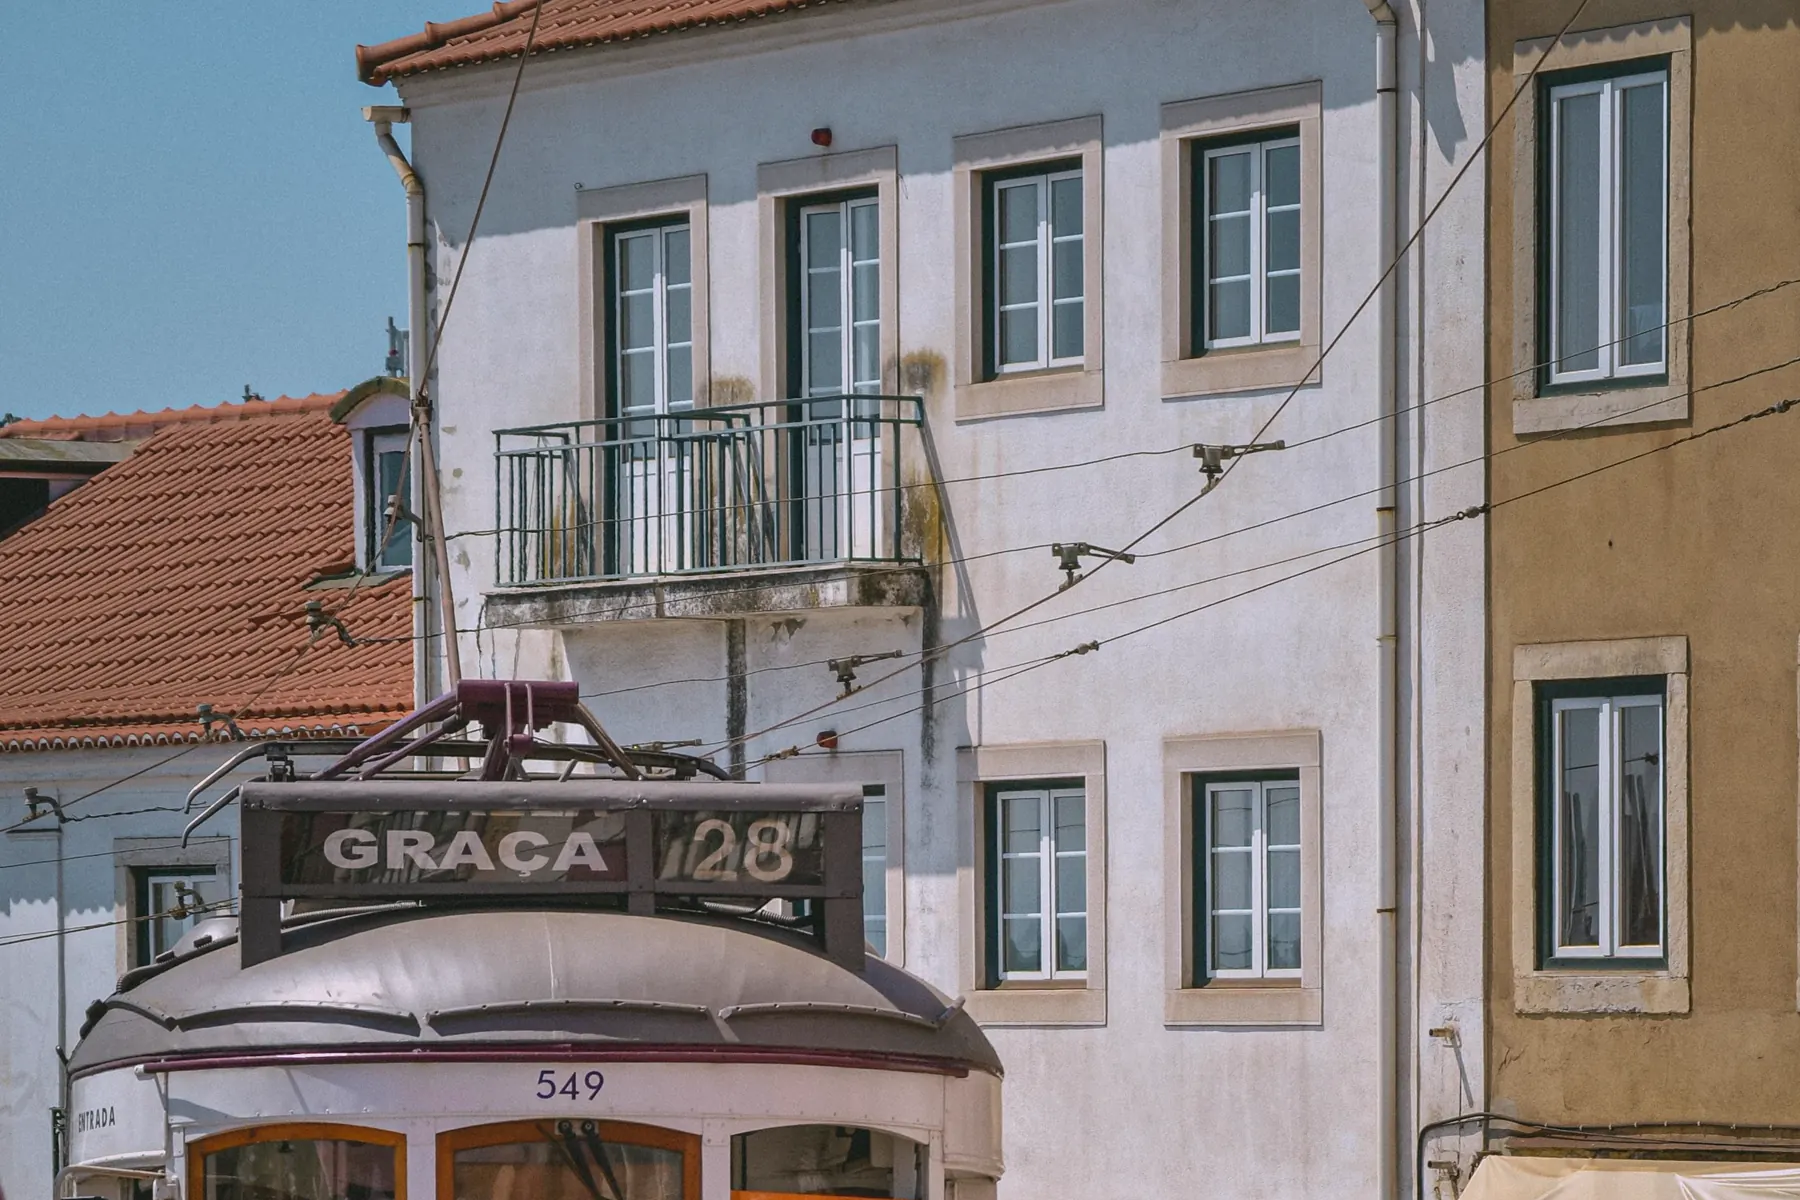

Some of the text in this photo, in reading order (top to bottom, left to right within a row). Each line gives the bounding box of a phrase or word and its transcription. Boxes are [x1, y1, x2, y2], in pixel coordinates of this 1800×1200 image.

[323, 829, 609, 877] GRAÇA
[693, 818, 793, 881] 28
[536, 1069, 605, 1101] 549
[78, 1105, 116, 1133] ENTRADA
